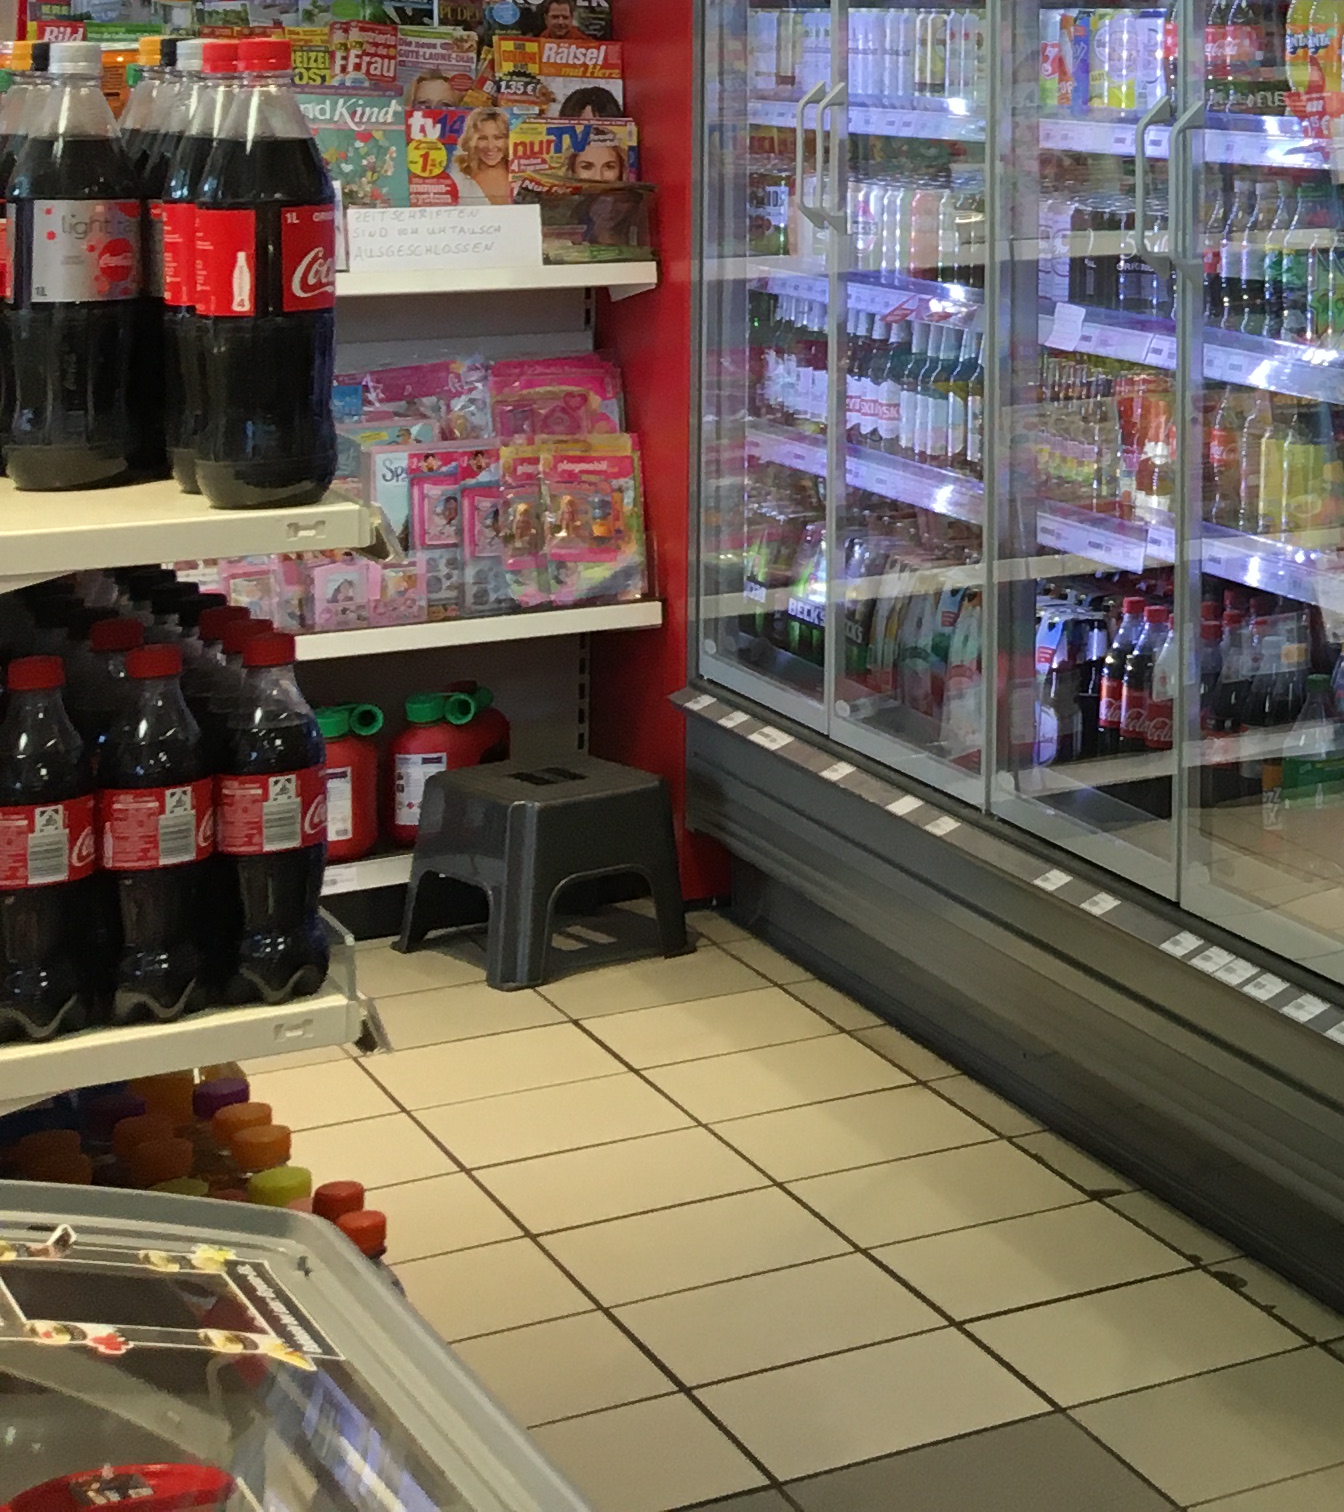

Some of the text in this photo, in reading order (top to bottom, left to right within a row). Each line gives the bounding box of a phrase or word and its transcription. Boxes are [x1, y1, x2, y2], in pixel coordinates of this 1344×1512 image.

[347, 50, 397, 78] Frau
[542, 42, 607, 65] Rätsel
[333, 97, 399, 131] Kind
